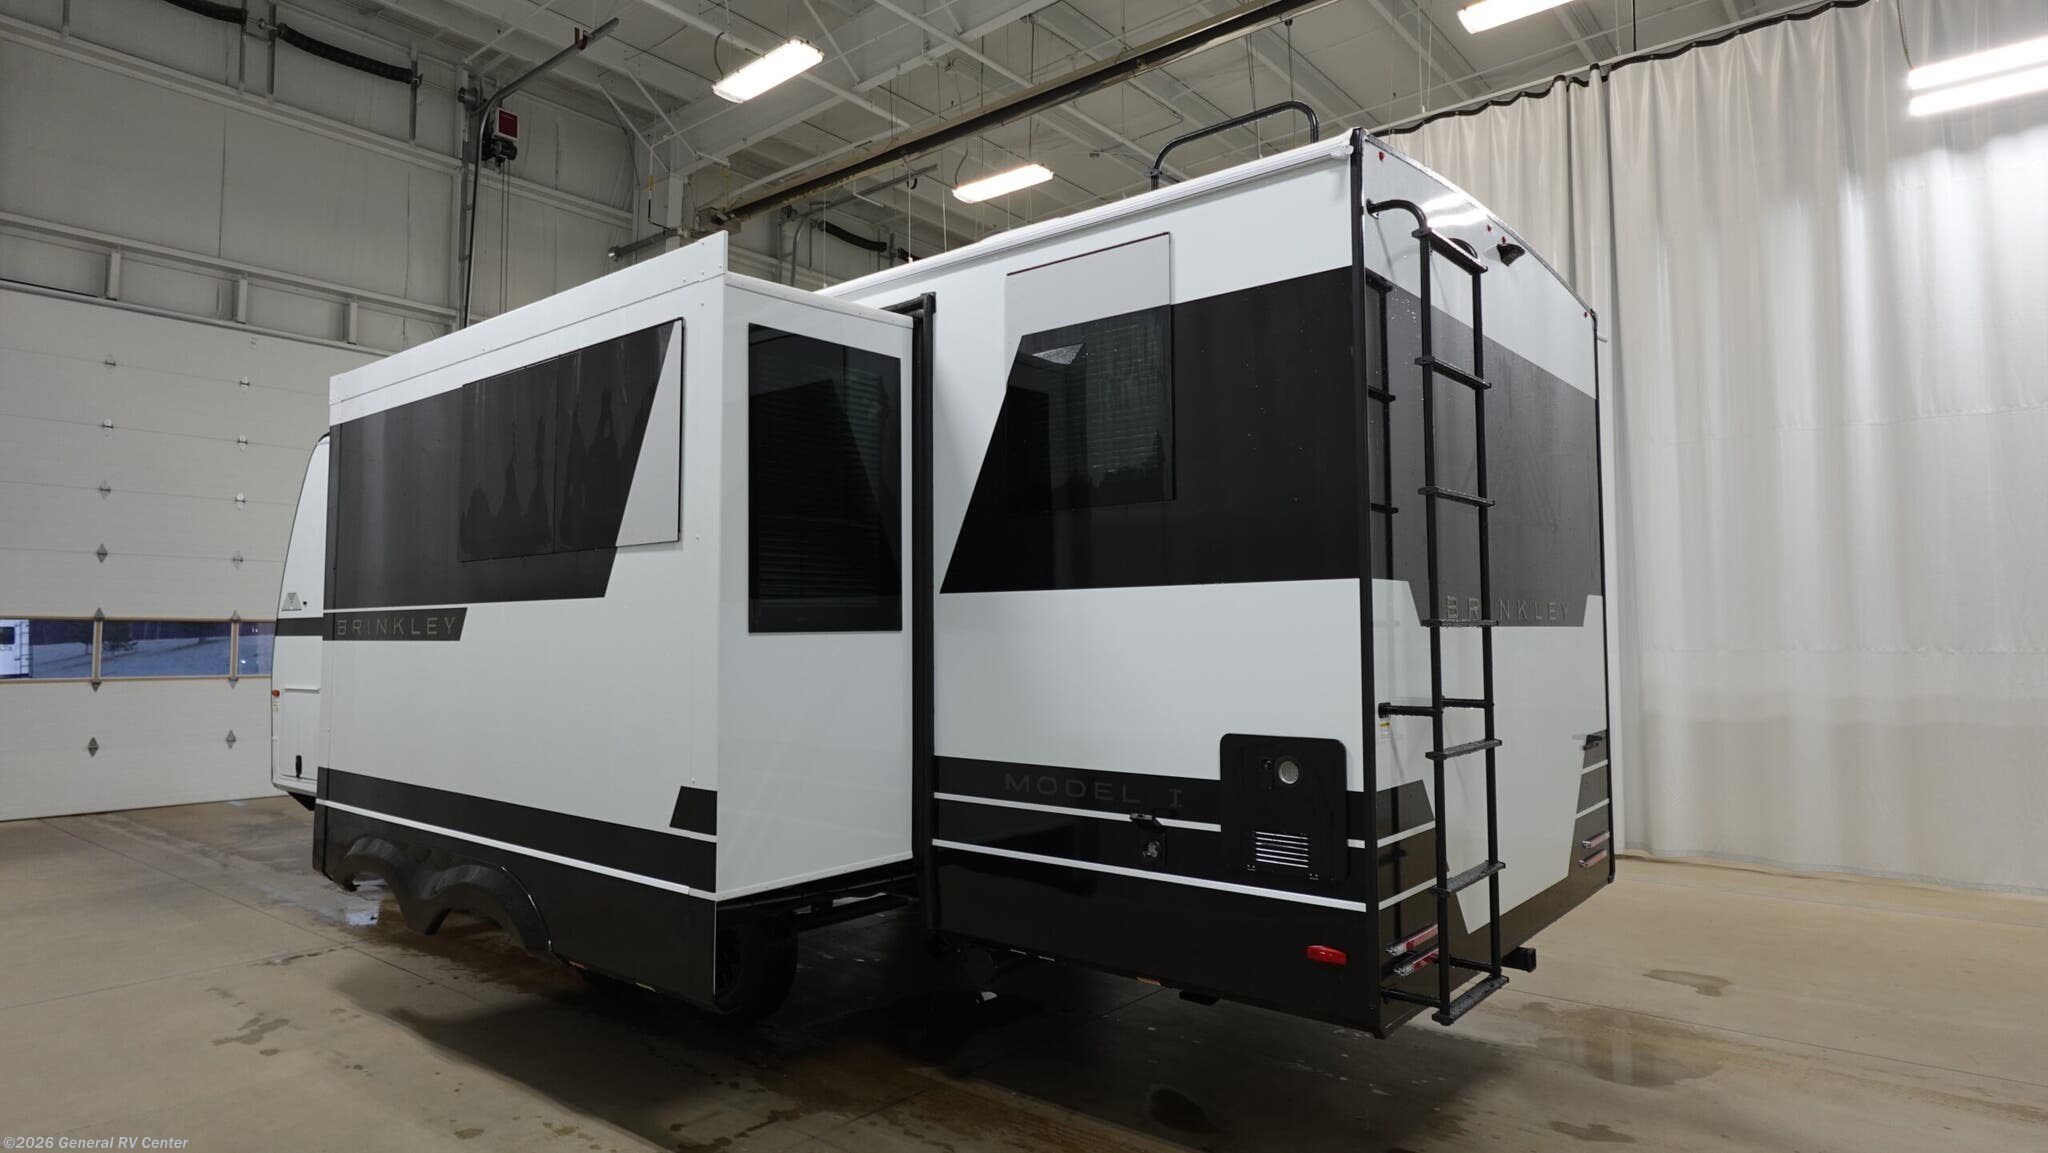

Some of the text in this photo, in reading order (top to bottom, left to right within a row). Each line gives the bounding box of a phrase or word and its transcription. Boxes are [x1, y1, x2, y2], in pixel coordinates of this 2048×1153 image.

[1447, 595, 1568, 621] BRNKLEY
[336, 617, 458, 636] BRINKLEY
[1005, 773, 1141, 804] MODEL
